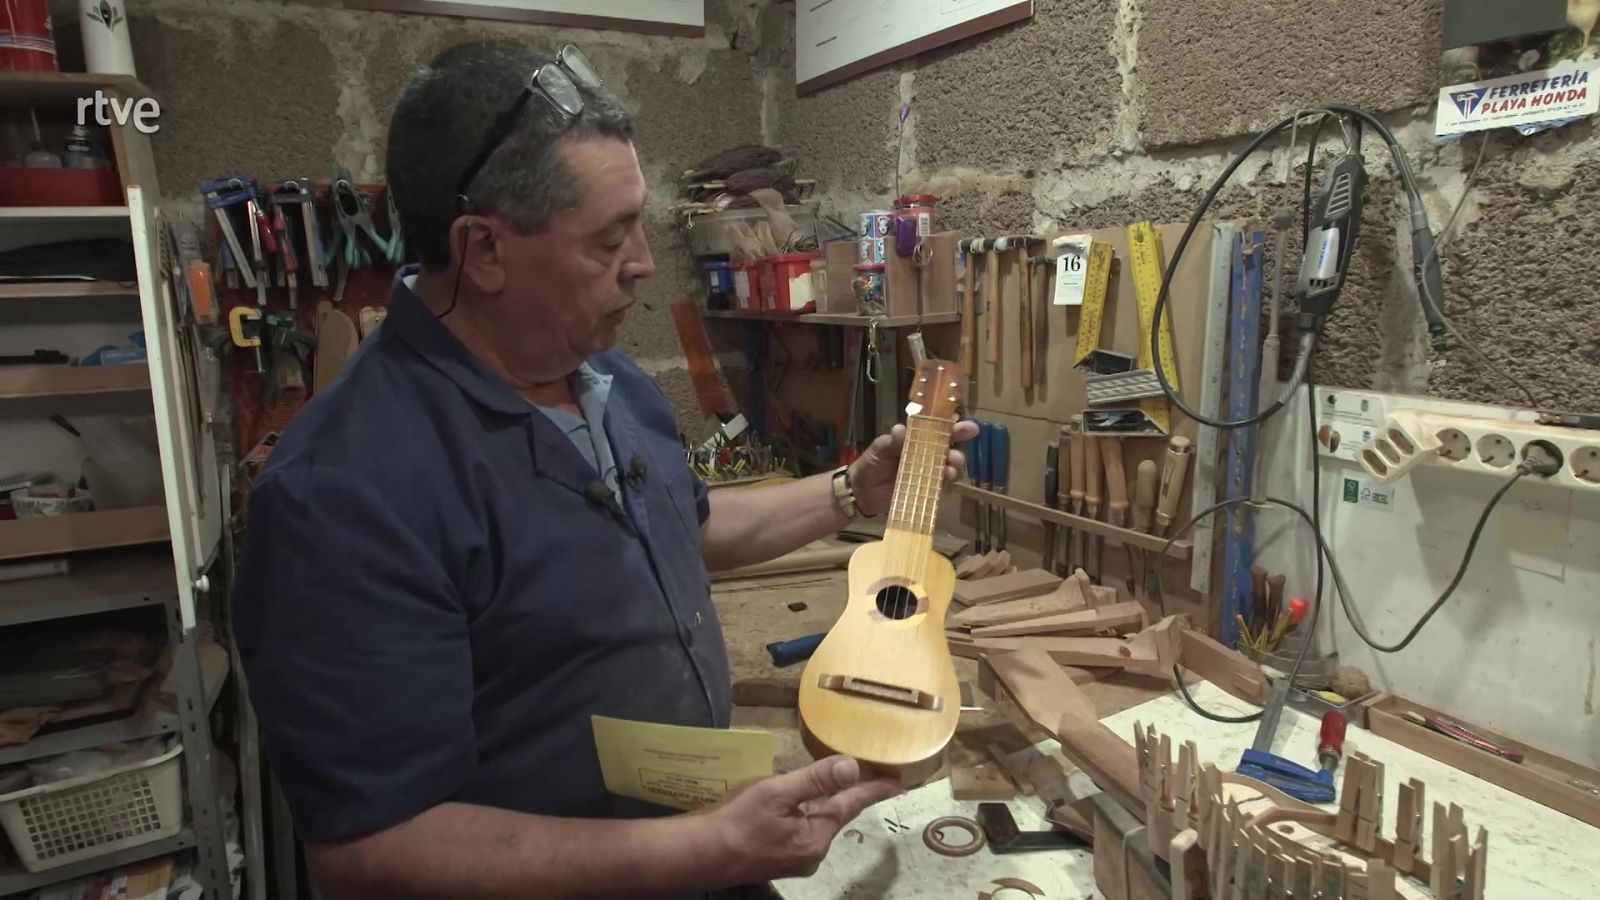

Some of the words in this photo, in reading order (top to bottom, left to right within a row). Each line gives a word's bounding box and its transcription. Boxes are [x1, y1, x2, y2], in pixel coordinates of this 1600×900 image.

[1489, 70, 1588, 99] FERRETERÍA
[1481, 98, 1527, 115] PLAYA
[1530, 87, 1587, 107] HONDA
[1063, 255, 1081, 272] 16
